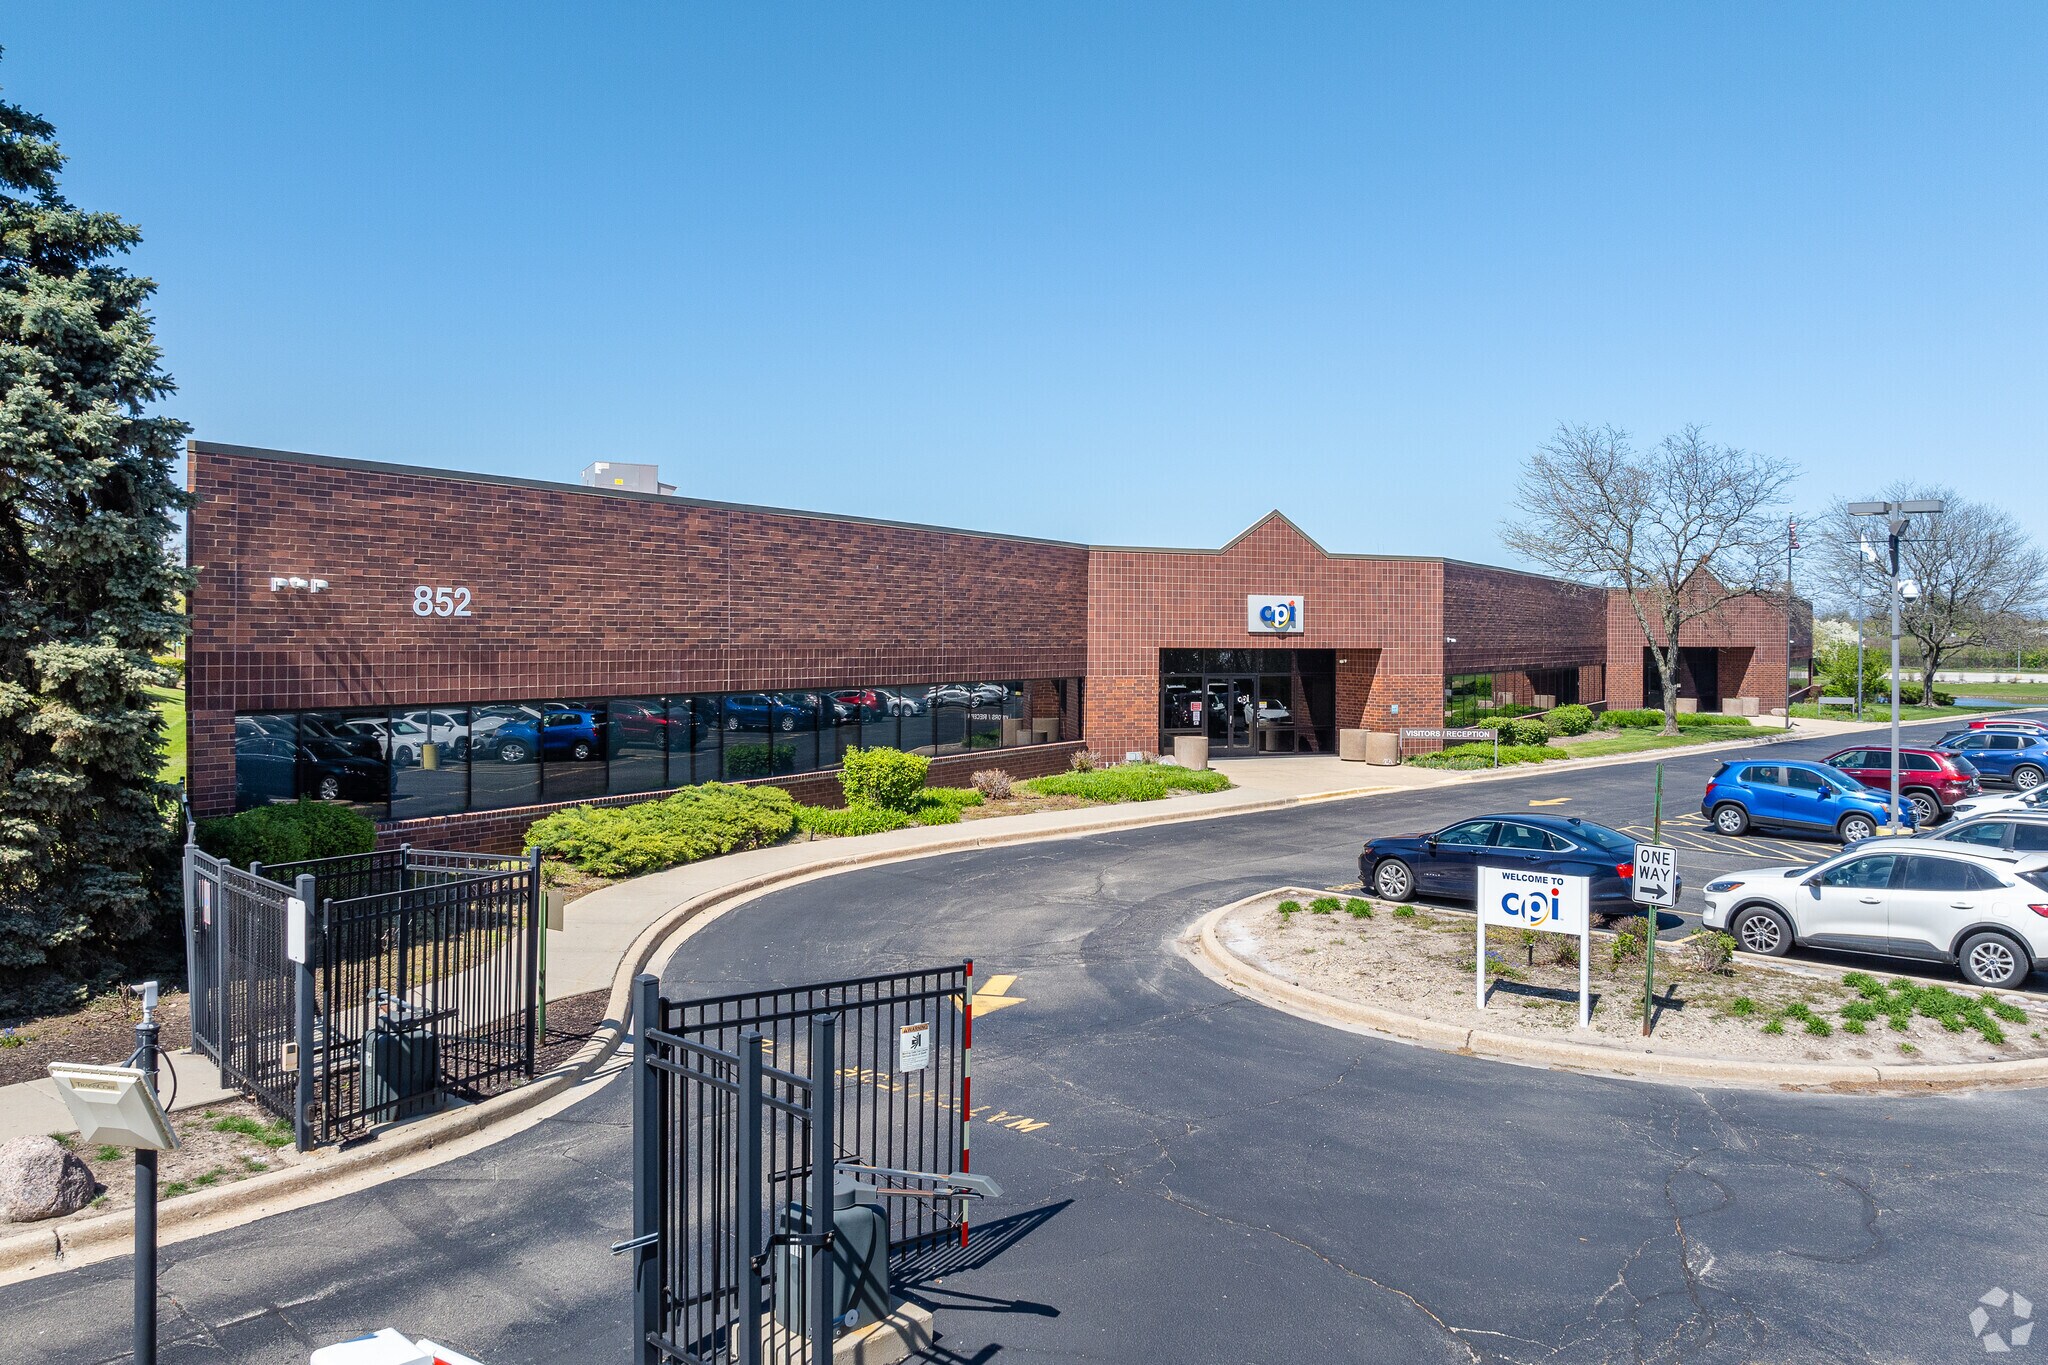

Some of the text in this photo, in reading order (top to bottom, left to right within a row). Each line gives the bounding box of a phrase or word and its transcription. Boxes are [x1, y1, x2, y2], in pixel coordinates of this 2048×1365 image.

[413, 585, 472, 617] 852
[1260, 600, 1295, 628] cpi
[1446, 730, 1490, 738] RECEPTION
[1641, 849, 1670, 866] ONE
[1502, 872, 1564, 886] WELCOME TO
[1639, 865, 1671, 882] WAY
[1501, 888, 1560, 927] cpi
